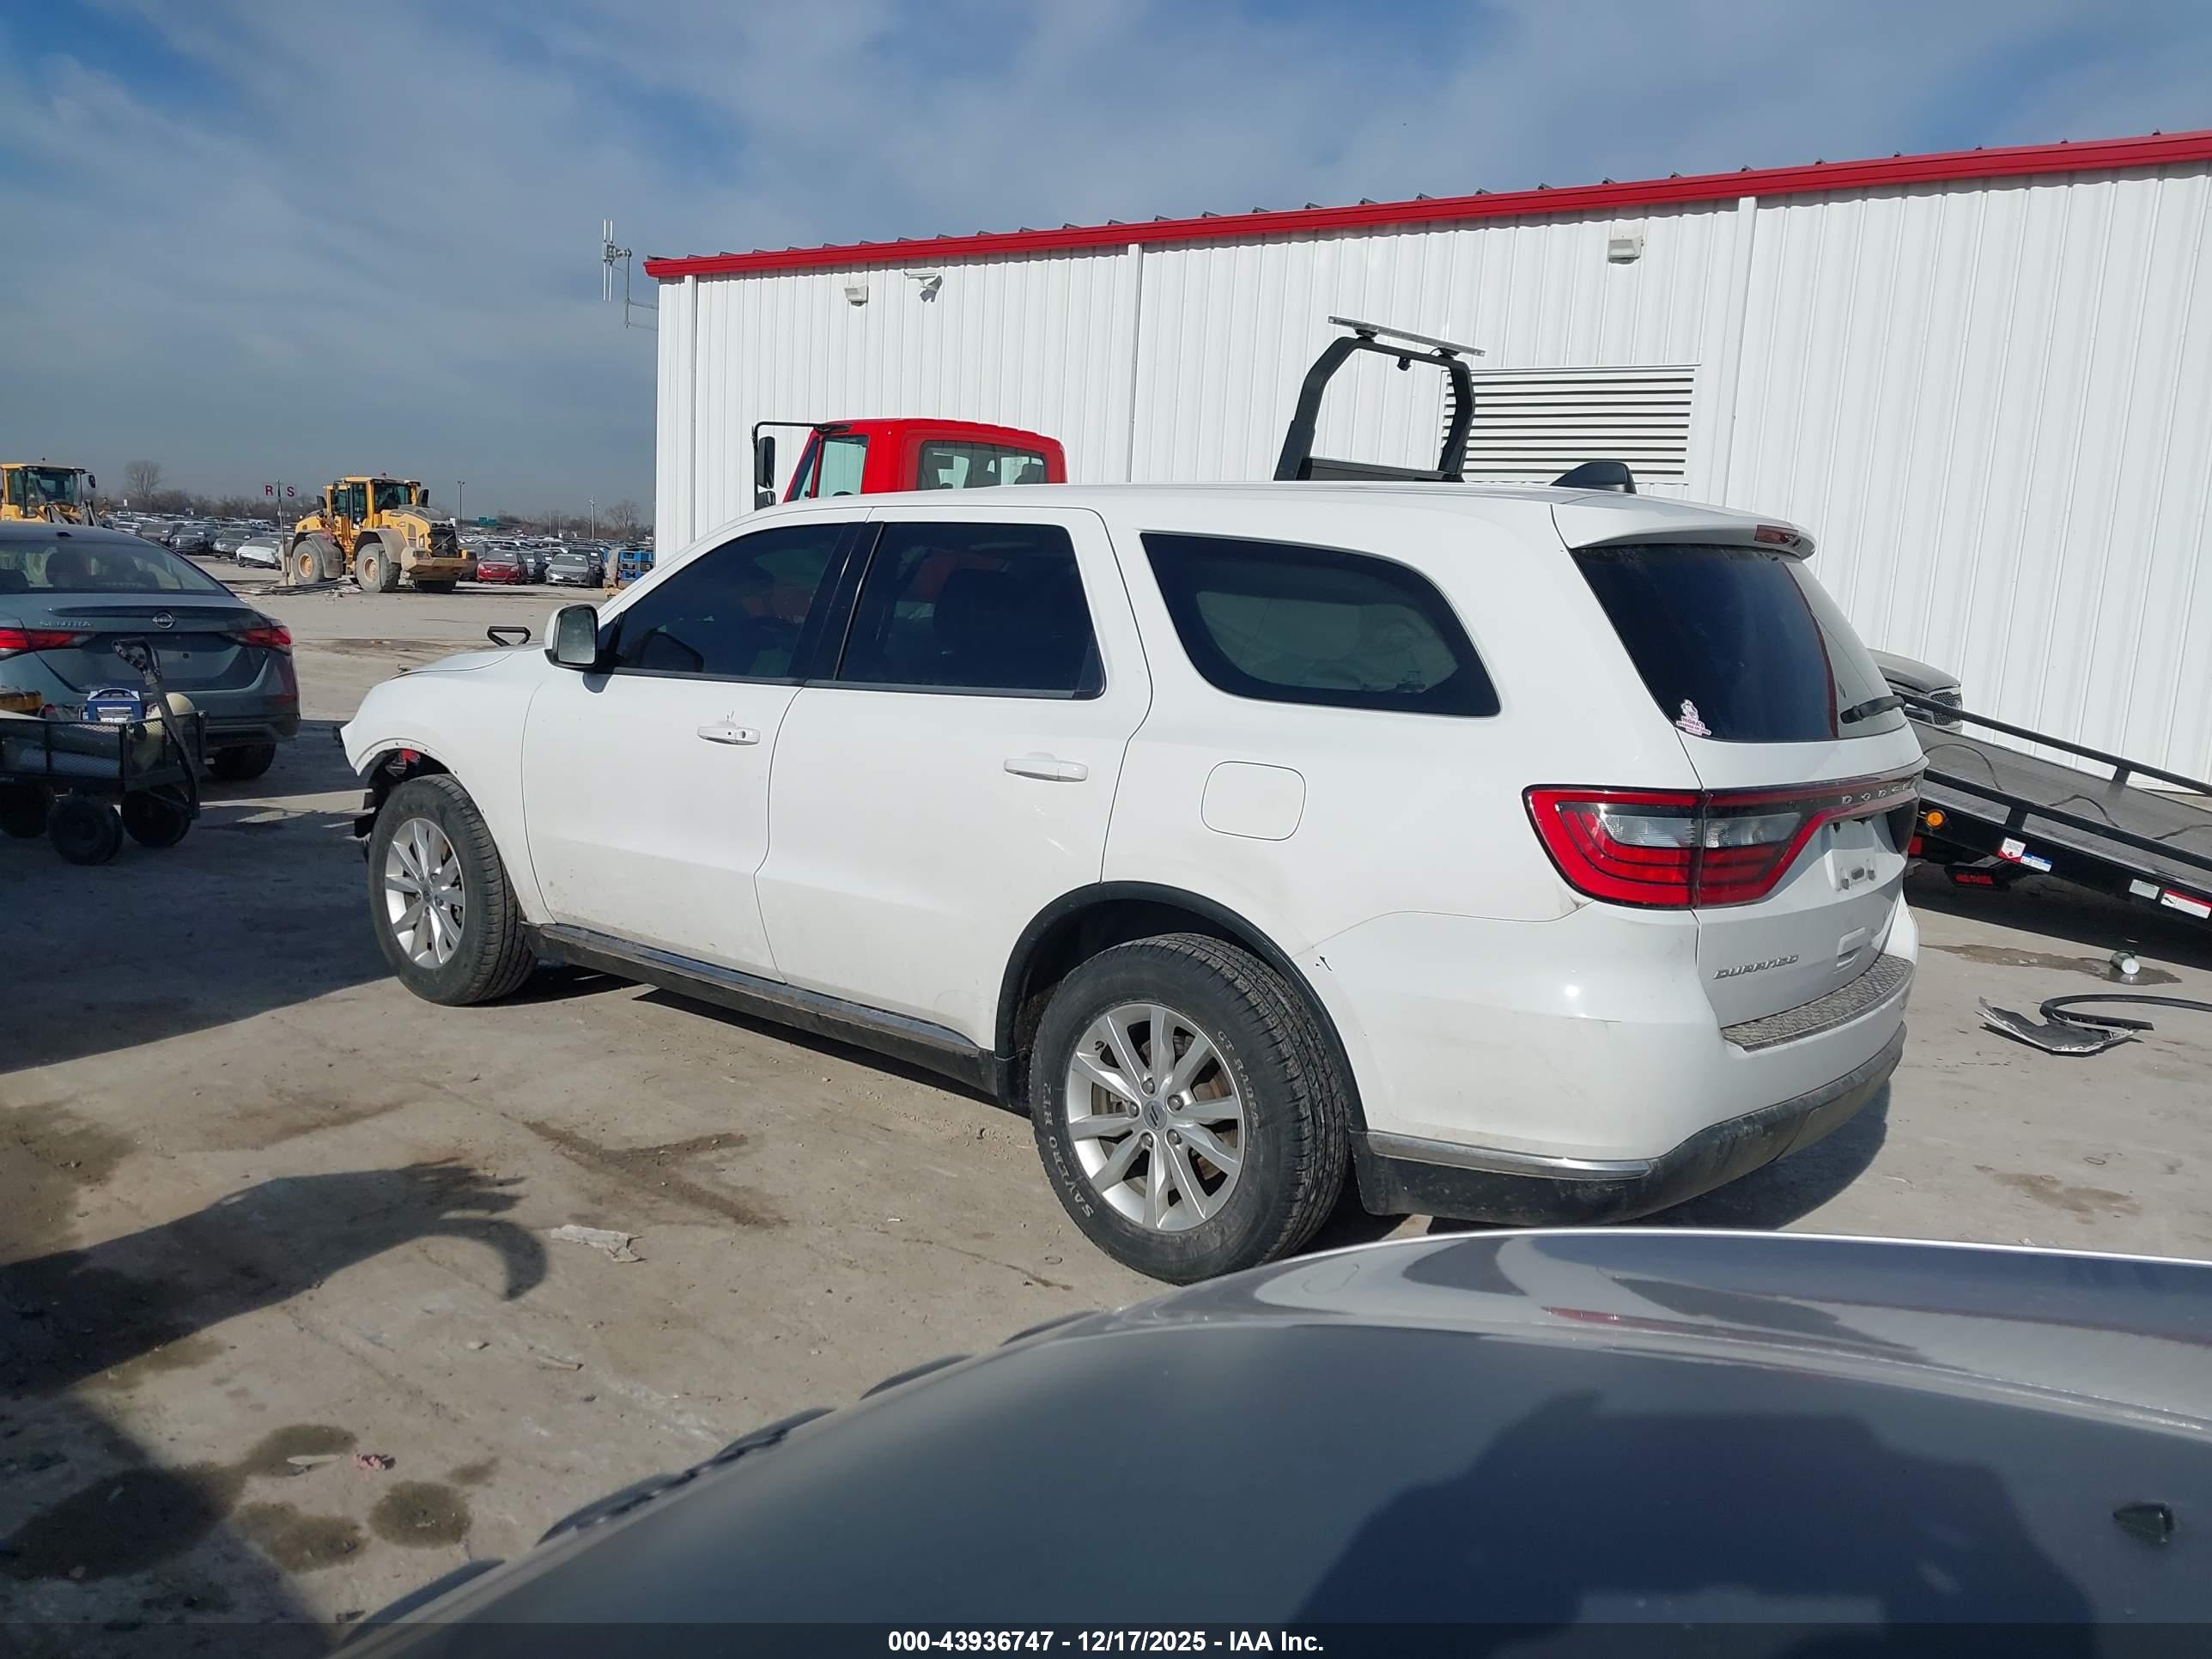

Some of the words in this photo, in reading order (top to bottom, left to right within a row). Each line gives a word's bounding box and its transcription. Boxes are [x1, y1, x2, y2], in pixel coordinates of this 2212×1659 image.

[265, 484, 273, 495] R
[287, 486, 295, 497] S
[1713, 955, 1799, 980] DURANGO
[1217, 1030, 1235, 1051] GT
[1048, 1135, 1094, 1218] SAVERO
